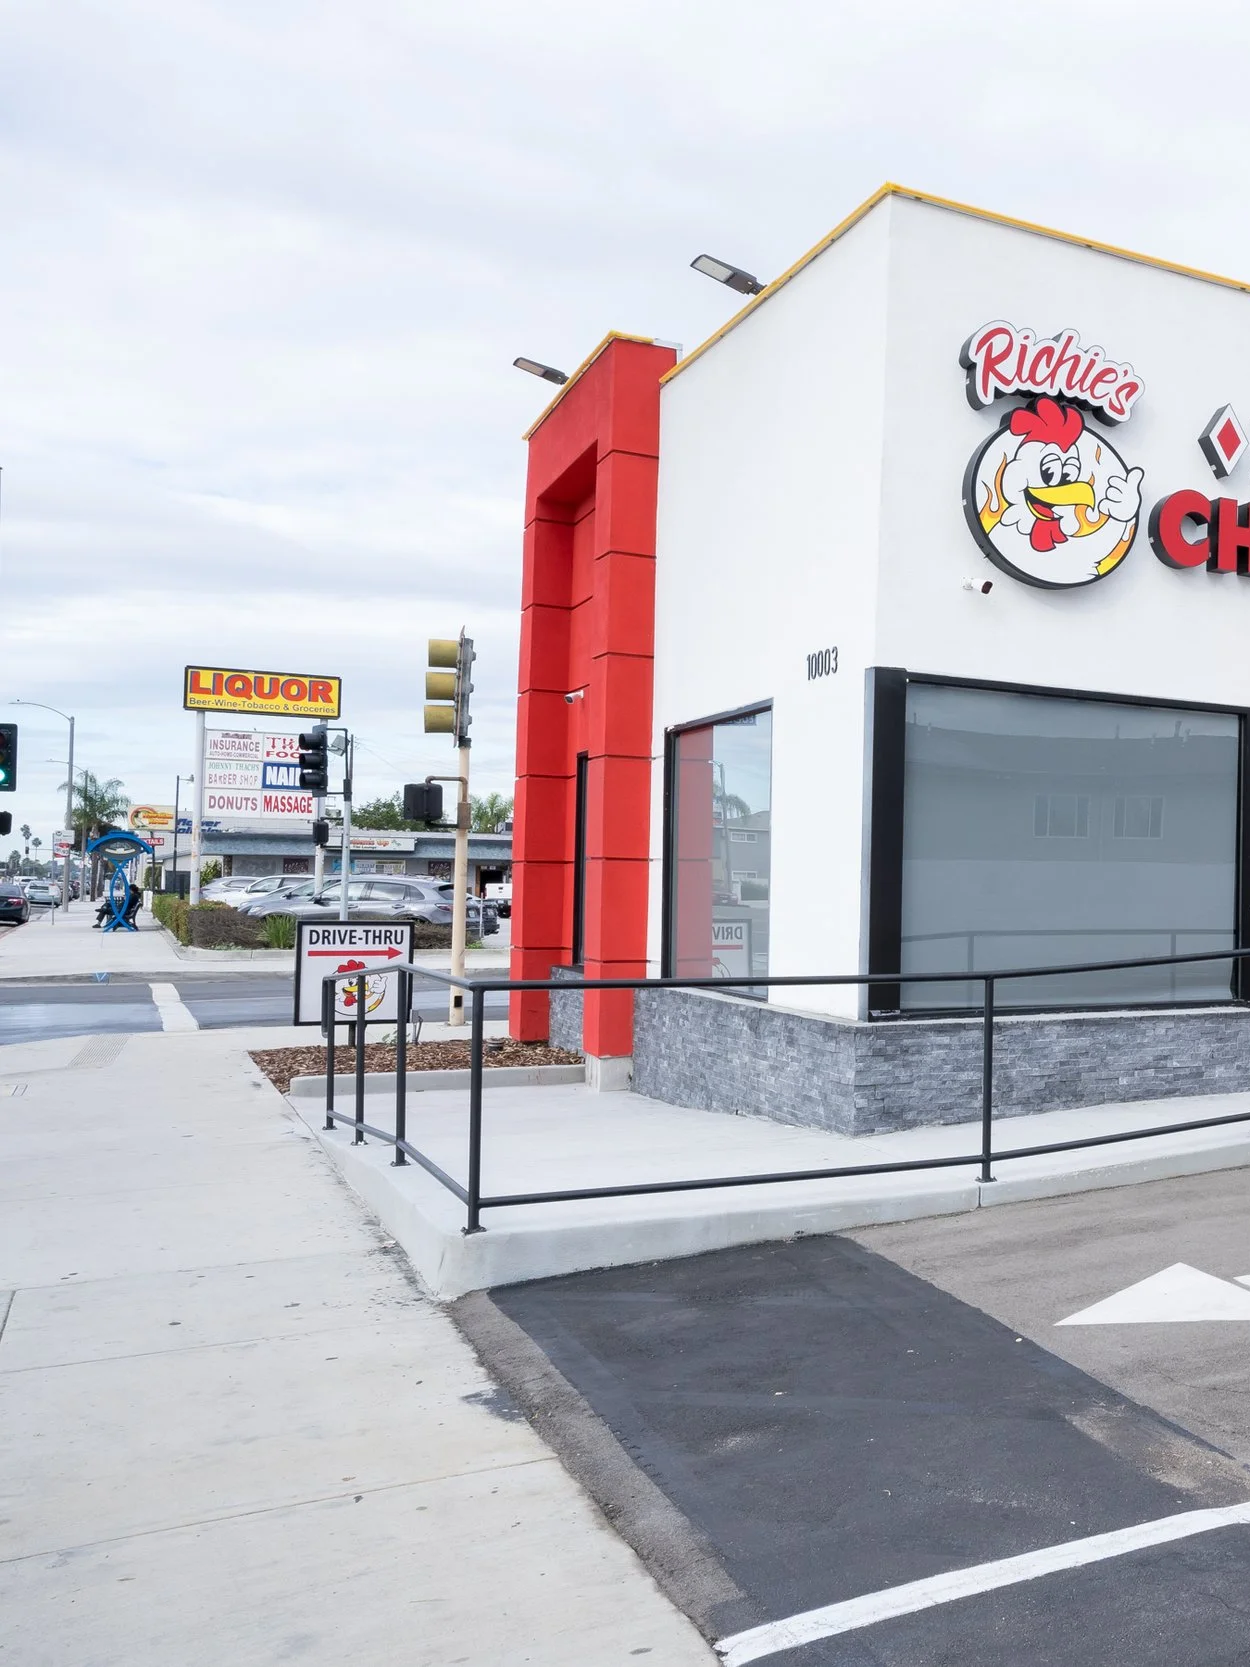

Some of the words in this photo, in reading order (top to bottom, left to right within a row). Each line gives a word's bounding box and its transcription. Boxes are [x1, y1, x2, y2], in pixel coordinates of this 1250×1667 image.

[972, 326, 1141, 418] Richie's
[806, 645, 838, 681] 10003
[189, 671, 334, 704] LIQUOR
[283, 703, 290, 711] &
[292, 704, 336, 714] Groceries
[209, 739, 260, 753] INSURANCE
[265, 750, 301, 759] FOO
[208, 773, 237, 785] BARBER
[240, 774, 259, 787] SHOP
[208, 795, 258, 811] DONUTS
[263, 795, 313, 814] MASSAGE
[309, 929, 404, 946] DRIVE-THRU
